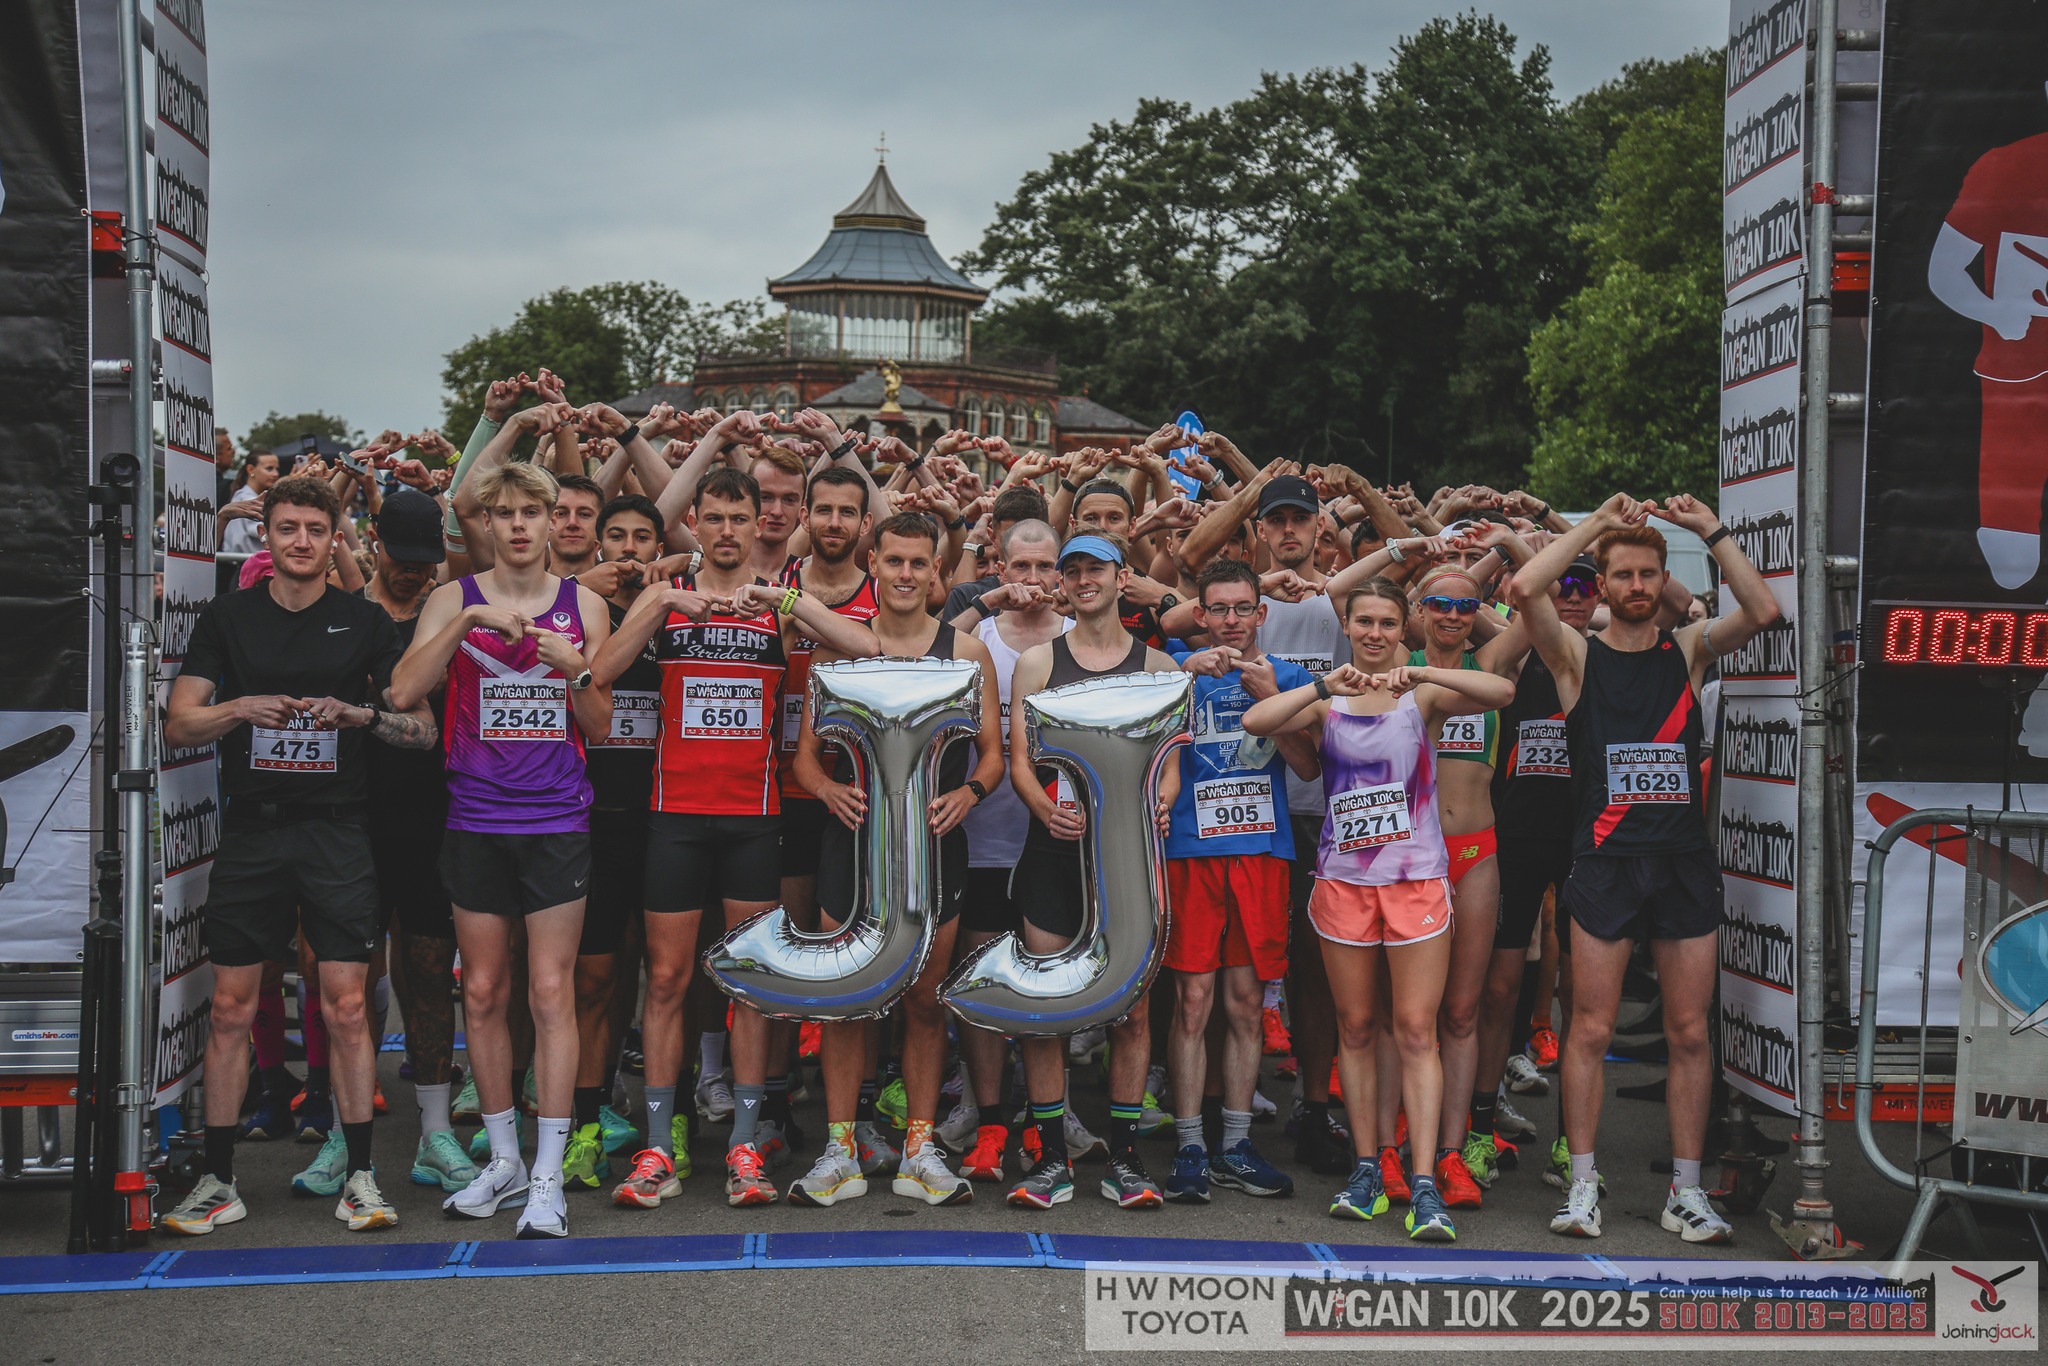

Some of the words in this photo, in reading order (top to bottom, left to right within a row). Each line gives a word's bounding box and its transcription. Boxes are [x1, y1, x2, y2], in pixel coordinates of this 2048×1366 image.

[1775, 0, 1804, 54] 10K
[193, 96, 209, 149] 10K
[1771, 103, 1800, 159] 10K
[195, 200, 208, 251] 10K
[1767, 208, 1800, 261] 10K
[193, 307, 211, 355] 10K
[1769, 315, 1798, 366] 10K
[198, 409, 215, 455] 10K
[1767, 420, 1794, 468] 10K
[199, 511, 215, 555] 10K
[1767, 525, 1793, 569] 10K
[672, 628, 697, 646] ST.
[704, 628, 768, 650] HELENS
[680, 645, 758, 661] Striders
[1768, 629, 1796, 673] 10K
[1306, 660, 1324, 671] 10K
[533, 687, 555, 699] 10K
[635, 699, 654, 709] 10K
[735, 687, 754, 698] 10K
[491, 709, 557, 728] 2542
[619, 718, 634, 736] 5
[701, 707, 748, 727] 650
[270, 740, 320, 760] 475
[1658, 751, 1678, 763] 10K
[1769, 734, 1796, 777] 10K
[1242, 784, 1262, 795] 10K
[1374, 792, 1395, 805] 10K
[1620, 773, 1681, 792] 1629
[200, 810, 219, 850] 10K
[1215, 805, 1259, 825] 905
[1342, 813, 1399, 841] 2271
[1766, 836, 1793, 881] 10K
[1765, 937, 1792, 986] 10K
[14, 1032, 79, 1040] smithshire.com
[1765, 1039, 1794, 1091] 10K
